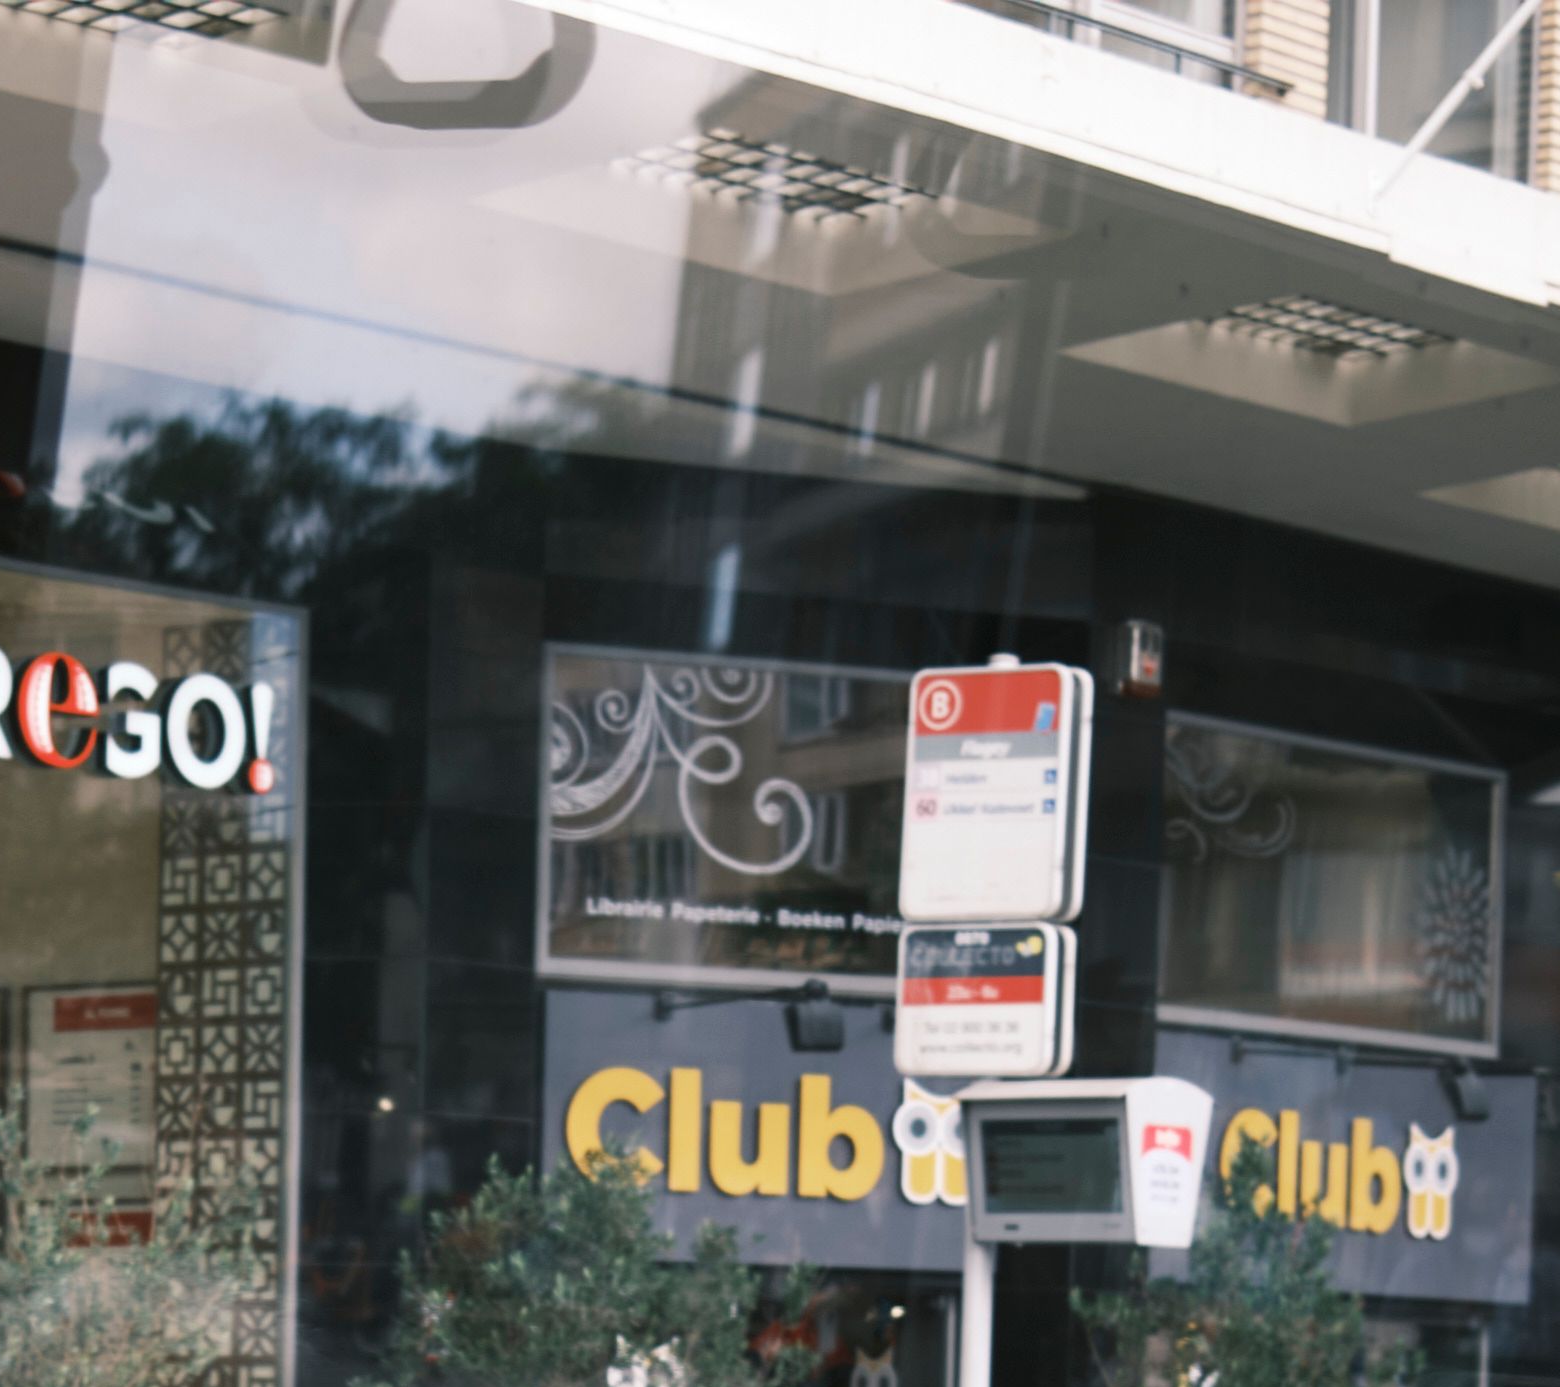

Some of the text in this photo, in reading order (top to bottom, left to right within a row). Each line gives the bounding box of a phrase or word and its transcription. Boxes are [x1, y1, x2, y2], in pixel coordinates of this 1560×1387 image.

[931, 690, 950, 720] B
[916, 798, 937, 817] 60
[586, 896, 664, 918] Librairie
[671, 901, 760, 925] Papeterie
[777, 908, 845, 929] Boeken
[852, 913, 903, 934] Papie
[566, 1065, 885, 1202] Club
[1218, 1107, 1403, 1236] Club
